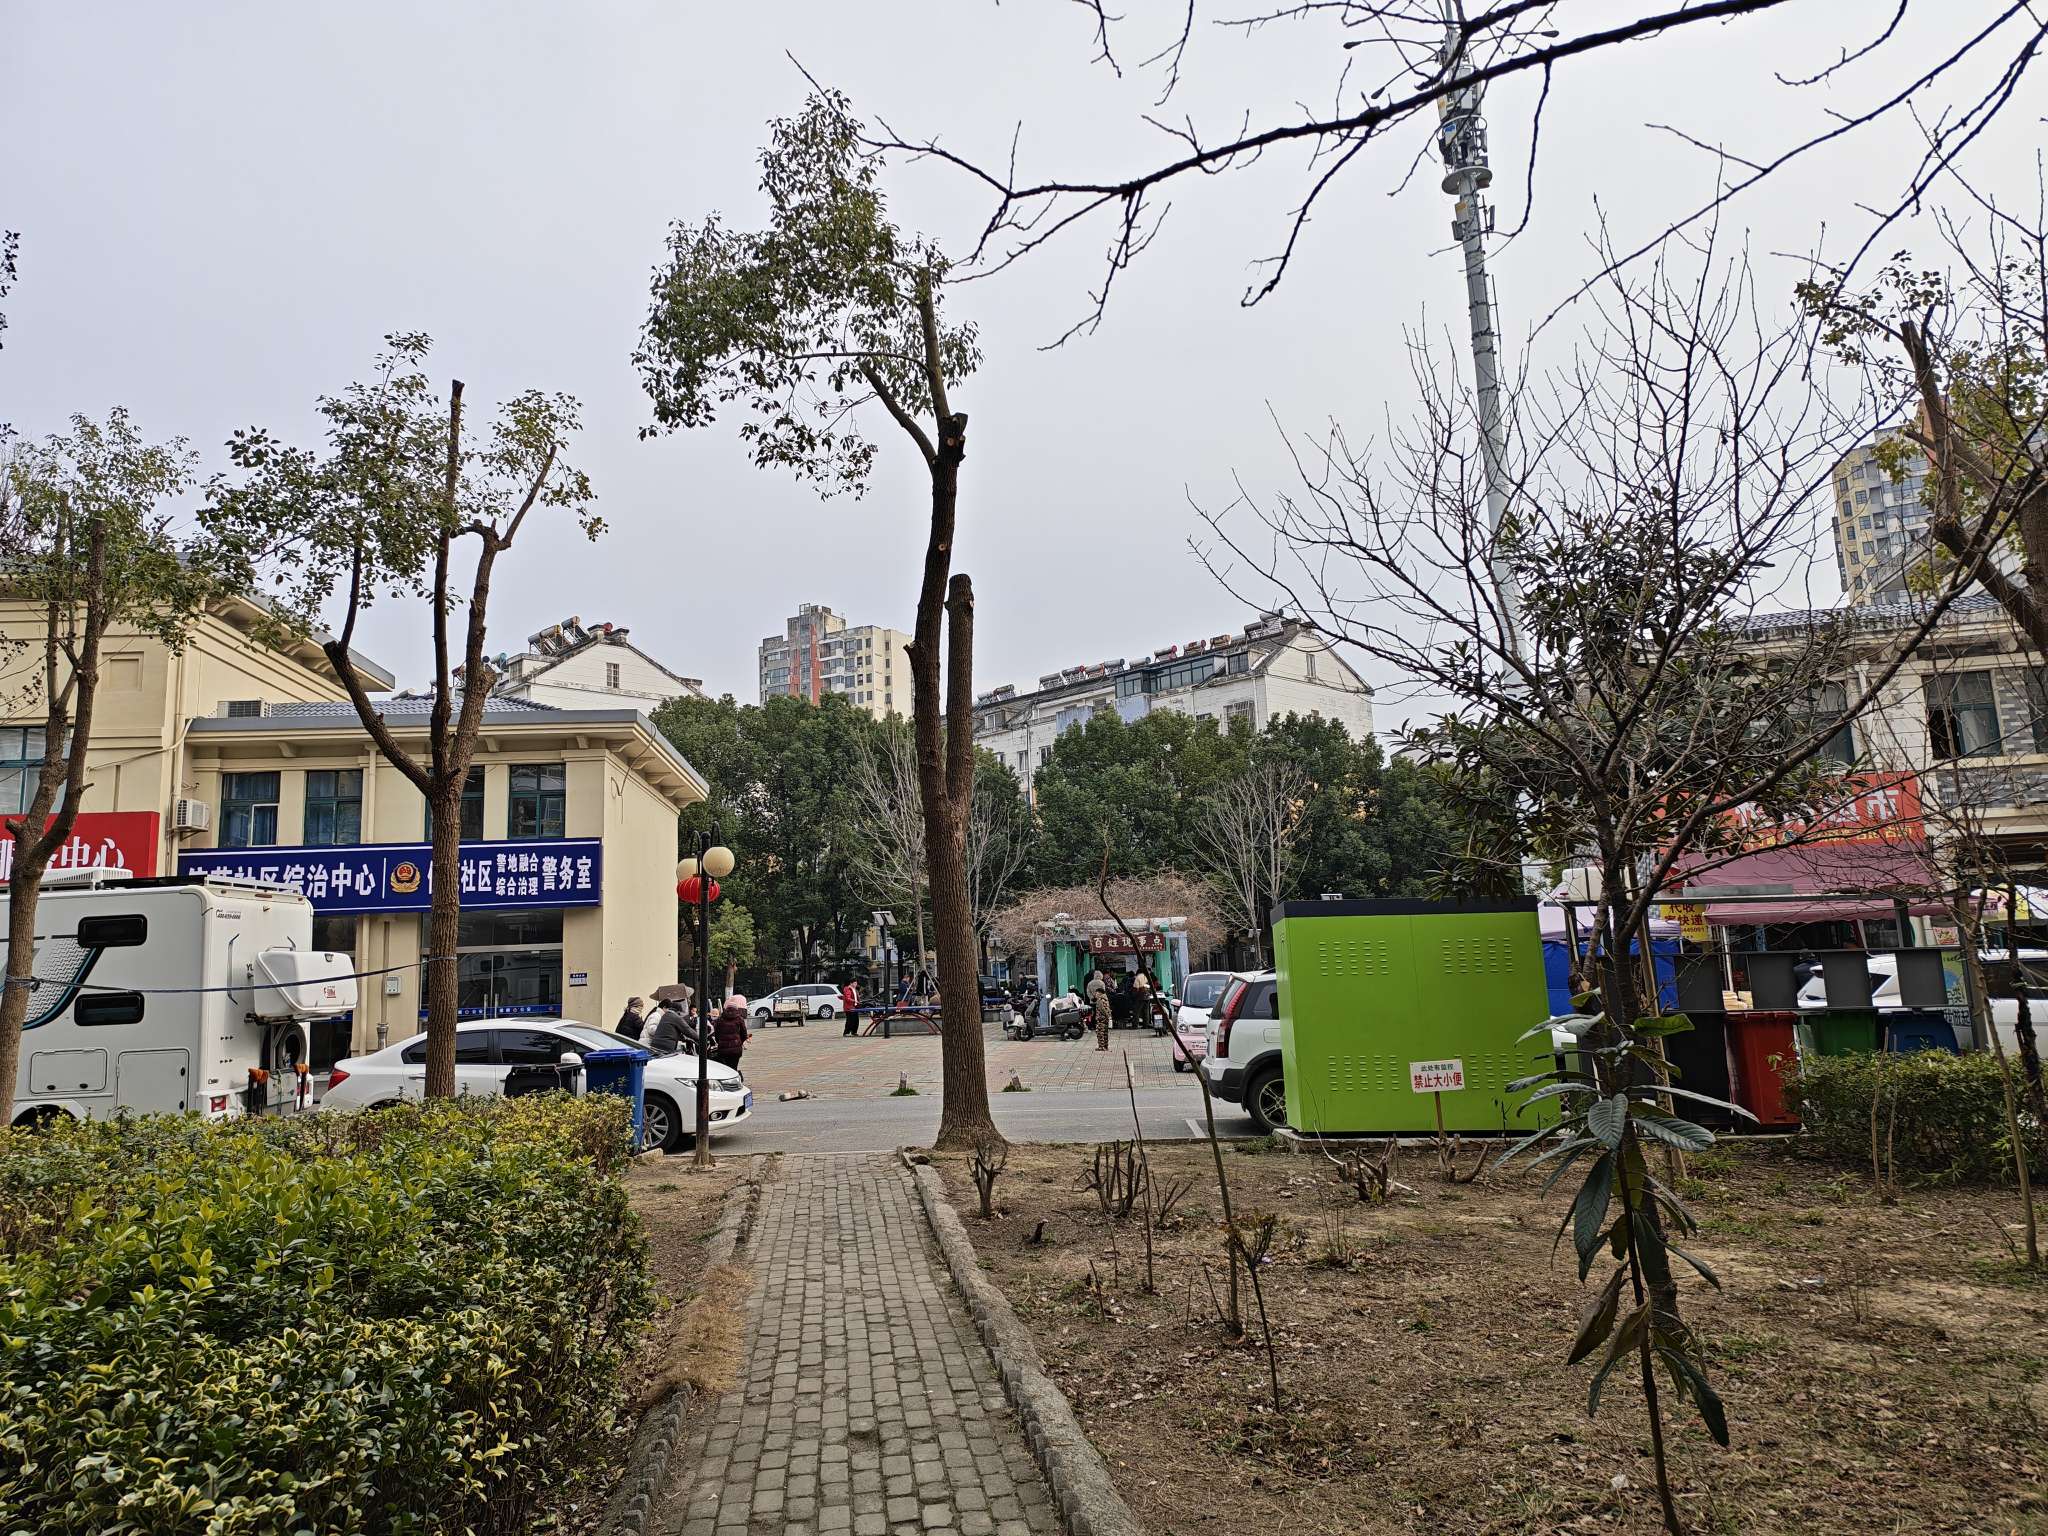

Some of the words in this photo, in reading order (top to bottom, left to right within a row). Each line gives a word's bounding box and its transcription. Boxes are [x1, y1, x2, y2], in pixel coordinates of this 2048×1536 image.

[0, 836, 124, 880] 中心
[496, 852, 539, 873] 警地融合
[428, 859, 493, 895] 社区
[496, 876, 539, 896] 综合治理
[542, 855, 592, 891] 警务室
[1413, 1071, 1463, 1089] 禁止大小便
